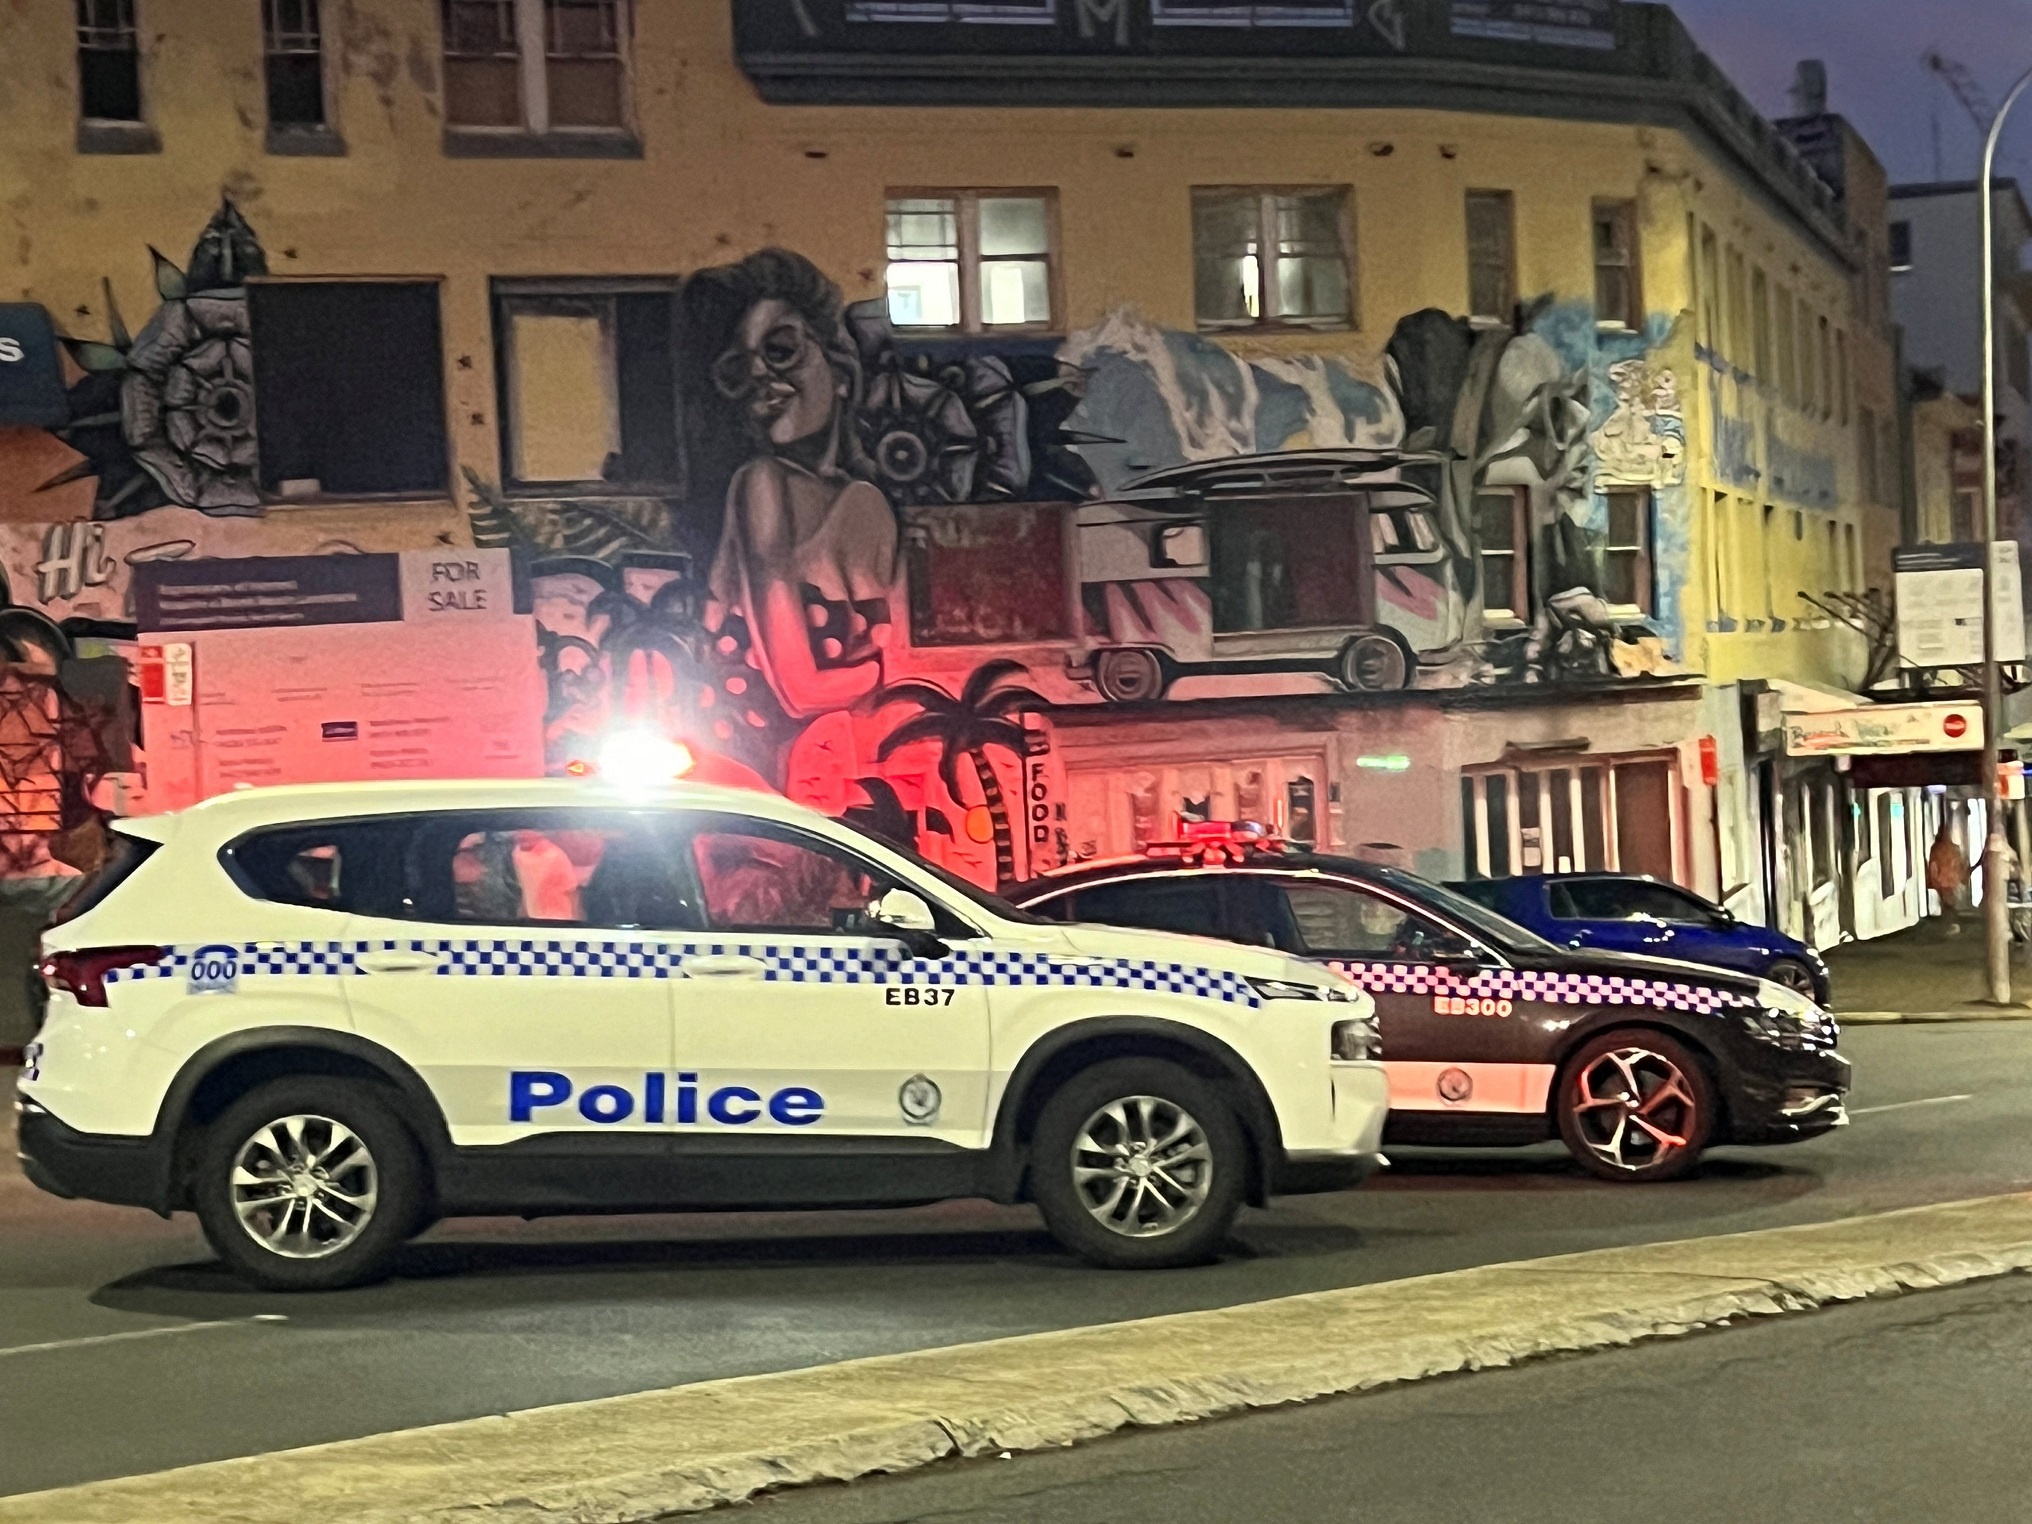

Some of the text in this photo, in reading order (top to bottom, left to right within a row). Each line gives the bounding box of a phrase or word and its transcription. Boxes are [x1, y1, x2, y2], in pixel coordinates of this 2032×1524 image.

[432, 561, 481, 582] FOR
[428, 589, 488, 611] SALE
[1030, 763, 1050, 843] FOOD
[191, 960, 237, 981] 000
[885, 987, 955, 1006] EB37
[509, 1071, 825, 1126] Police
